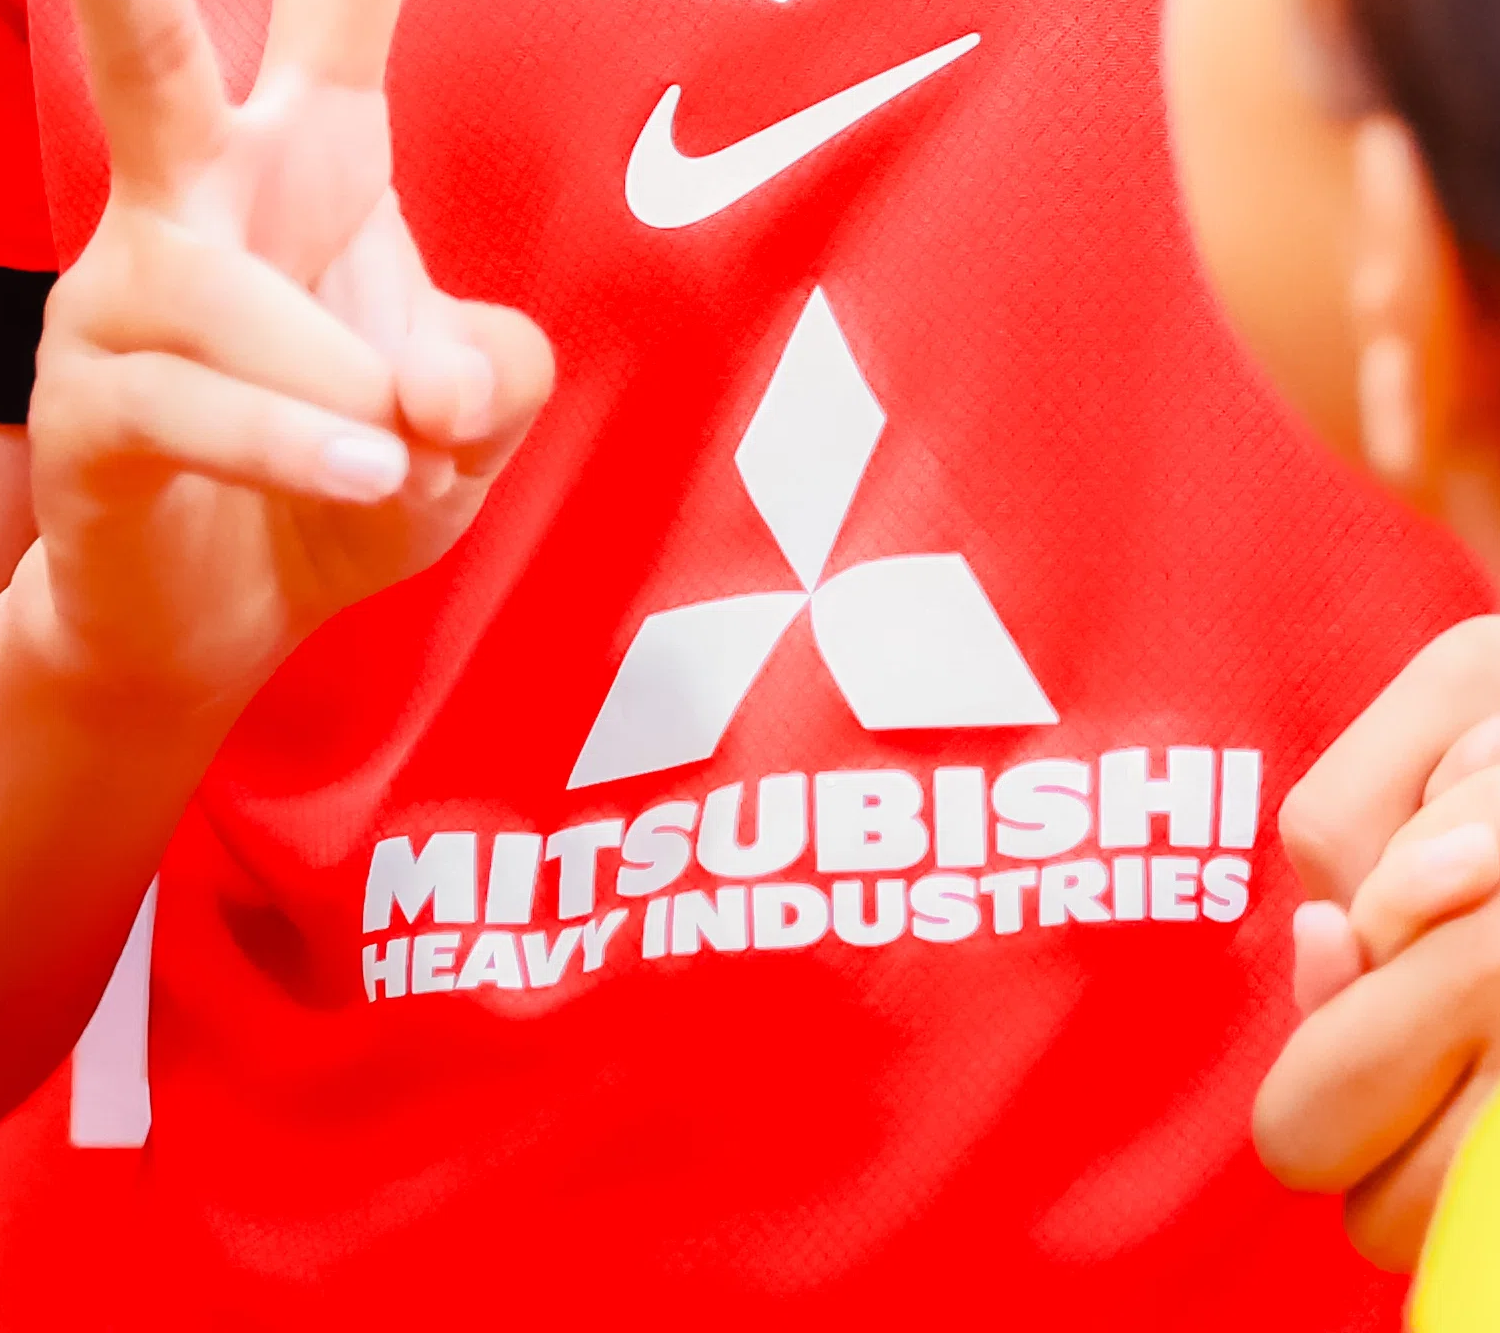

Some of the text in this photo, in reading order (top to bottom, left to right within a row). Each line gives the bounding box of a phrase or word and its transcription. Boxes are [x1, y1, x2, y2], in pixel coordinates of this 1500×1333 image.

[362, 746, 1263, 933] MITSUBISHI
[362, 857, 1252, 1004] HEAVY INDUSTRIES
